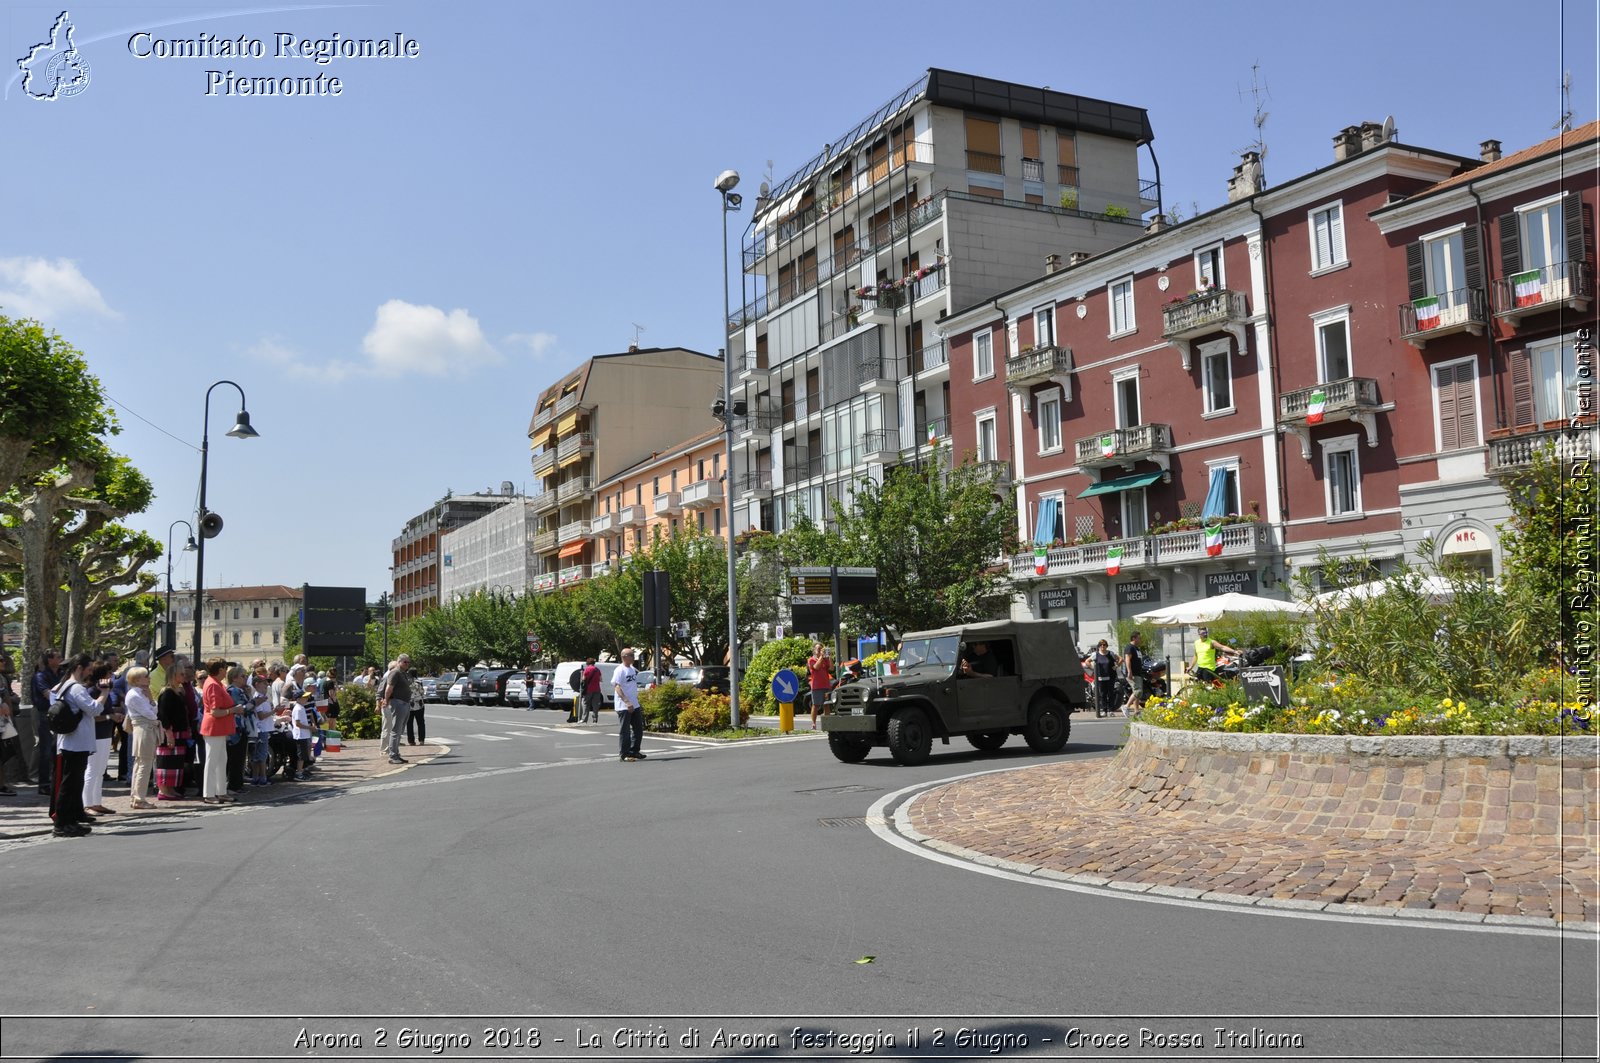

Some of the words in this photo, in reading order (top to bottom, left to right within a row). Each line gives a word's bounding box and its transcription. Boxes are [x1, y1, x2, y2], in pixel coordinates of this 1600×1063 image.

[1209, 573, 1250, 585] FARMACIA
[1118, 582, 1154, 593] FARMACIA
[1218, 583, 1242, 593] NEGRI
[1040, 590, 1072, 600] FARMACIA
[1126, 592, 1148, 601] NEGRI
[1047, 599, 1066, 608] NEGRI
